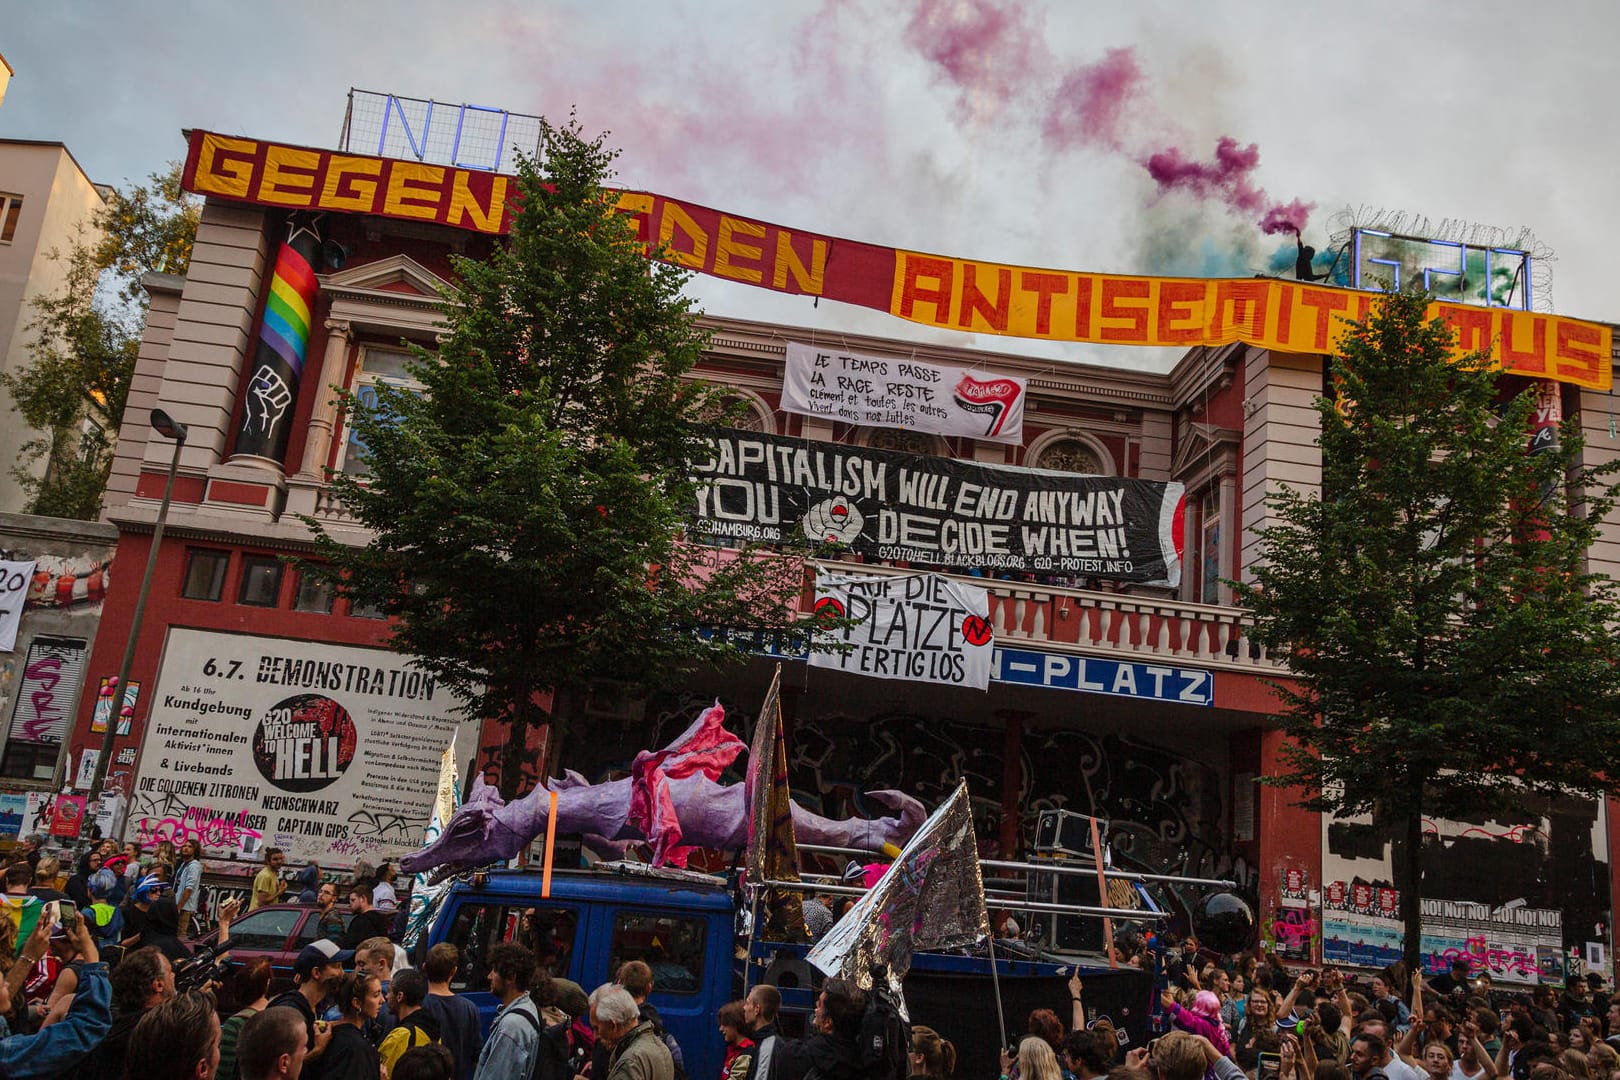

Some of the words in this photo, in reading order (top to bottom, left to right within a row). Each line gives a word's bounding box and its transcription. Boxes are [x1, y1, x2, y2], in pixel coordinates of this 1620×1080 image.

[194, 134, 508, 233] GEGEN
[815, 353, 830, 368] LE
[839, 357, 888, 375] TEMPS
[898, 364, 941, 382] PASSE
[810, 371, 826, 387] LA
[837, 376, 874, 393] RAGE
[886, 383, 935, 402] RESTE
[848, 395, 858, 405] et
[865, 396, 896, 410] toutes
[920, 406, 948, 419] autres
[866, 410, 880, 422] nos
[686, 437, 886, 501] CAPITALISM
[899, 469, 950, 511] WILL
[954, 481, 1018, 520] END
[1023, 488, 1125, 526] ANYWAY
[689, 476, 780, 525] YOU
[879, 509, 1011, 555] DECIDE
[1022, 525, 1130, 558] WHEN!
[906, 576, 948, 604] DIE
[844, 594, 966, 652] PLÄTZE
[841, 643, 925, 677] FERTIG
[930, 651, 965, 682] LOS
[202, 657, 245, 680] 6.7.
[256, 655, 437, 701] DEMONSTRATION
[193, 686, 202, 694] 16
[203, 687, 216, 695] Uhr
[164, 695, 252, 720] Kundgebung
[262, 708, 291, 725] G20
[156, 723, 248, 744] internationalen
[264, 723, 317, 740] WELCOME
[160, 758, 169, 768] &
[174, 761, 233, 776] Livebands
[264, 740, 276, 753] TO
[274, 737, 343, 780] HELL
[139, 777, 156, 792] DIE
[157, 778, 207, 797] GOLDENEN
[208, 783, 259, 801] ZITRONEN
[182, 806, 224, 822] JOHNNY
[224, 812, 265, 830] MAUSER
[262, 796, 339, 816] NEONSCHWARZ
[277, 817, 324, 836] CAPTAIN
[325, 823, 349, 839] GIPS
[1421, 900, 1442, 916] NO!
[1468, 905, 1490, 921] NO!
[1516, 909, 1537, 926] NO!
[1539, 910, 1560, 927] NO!
